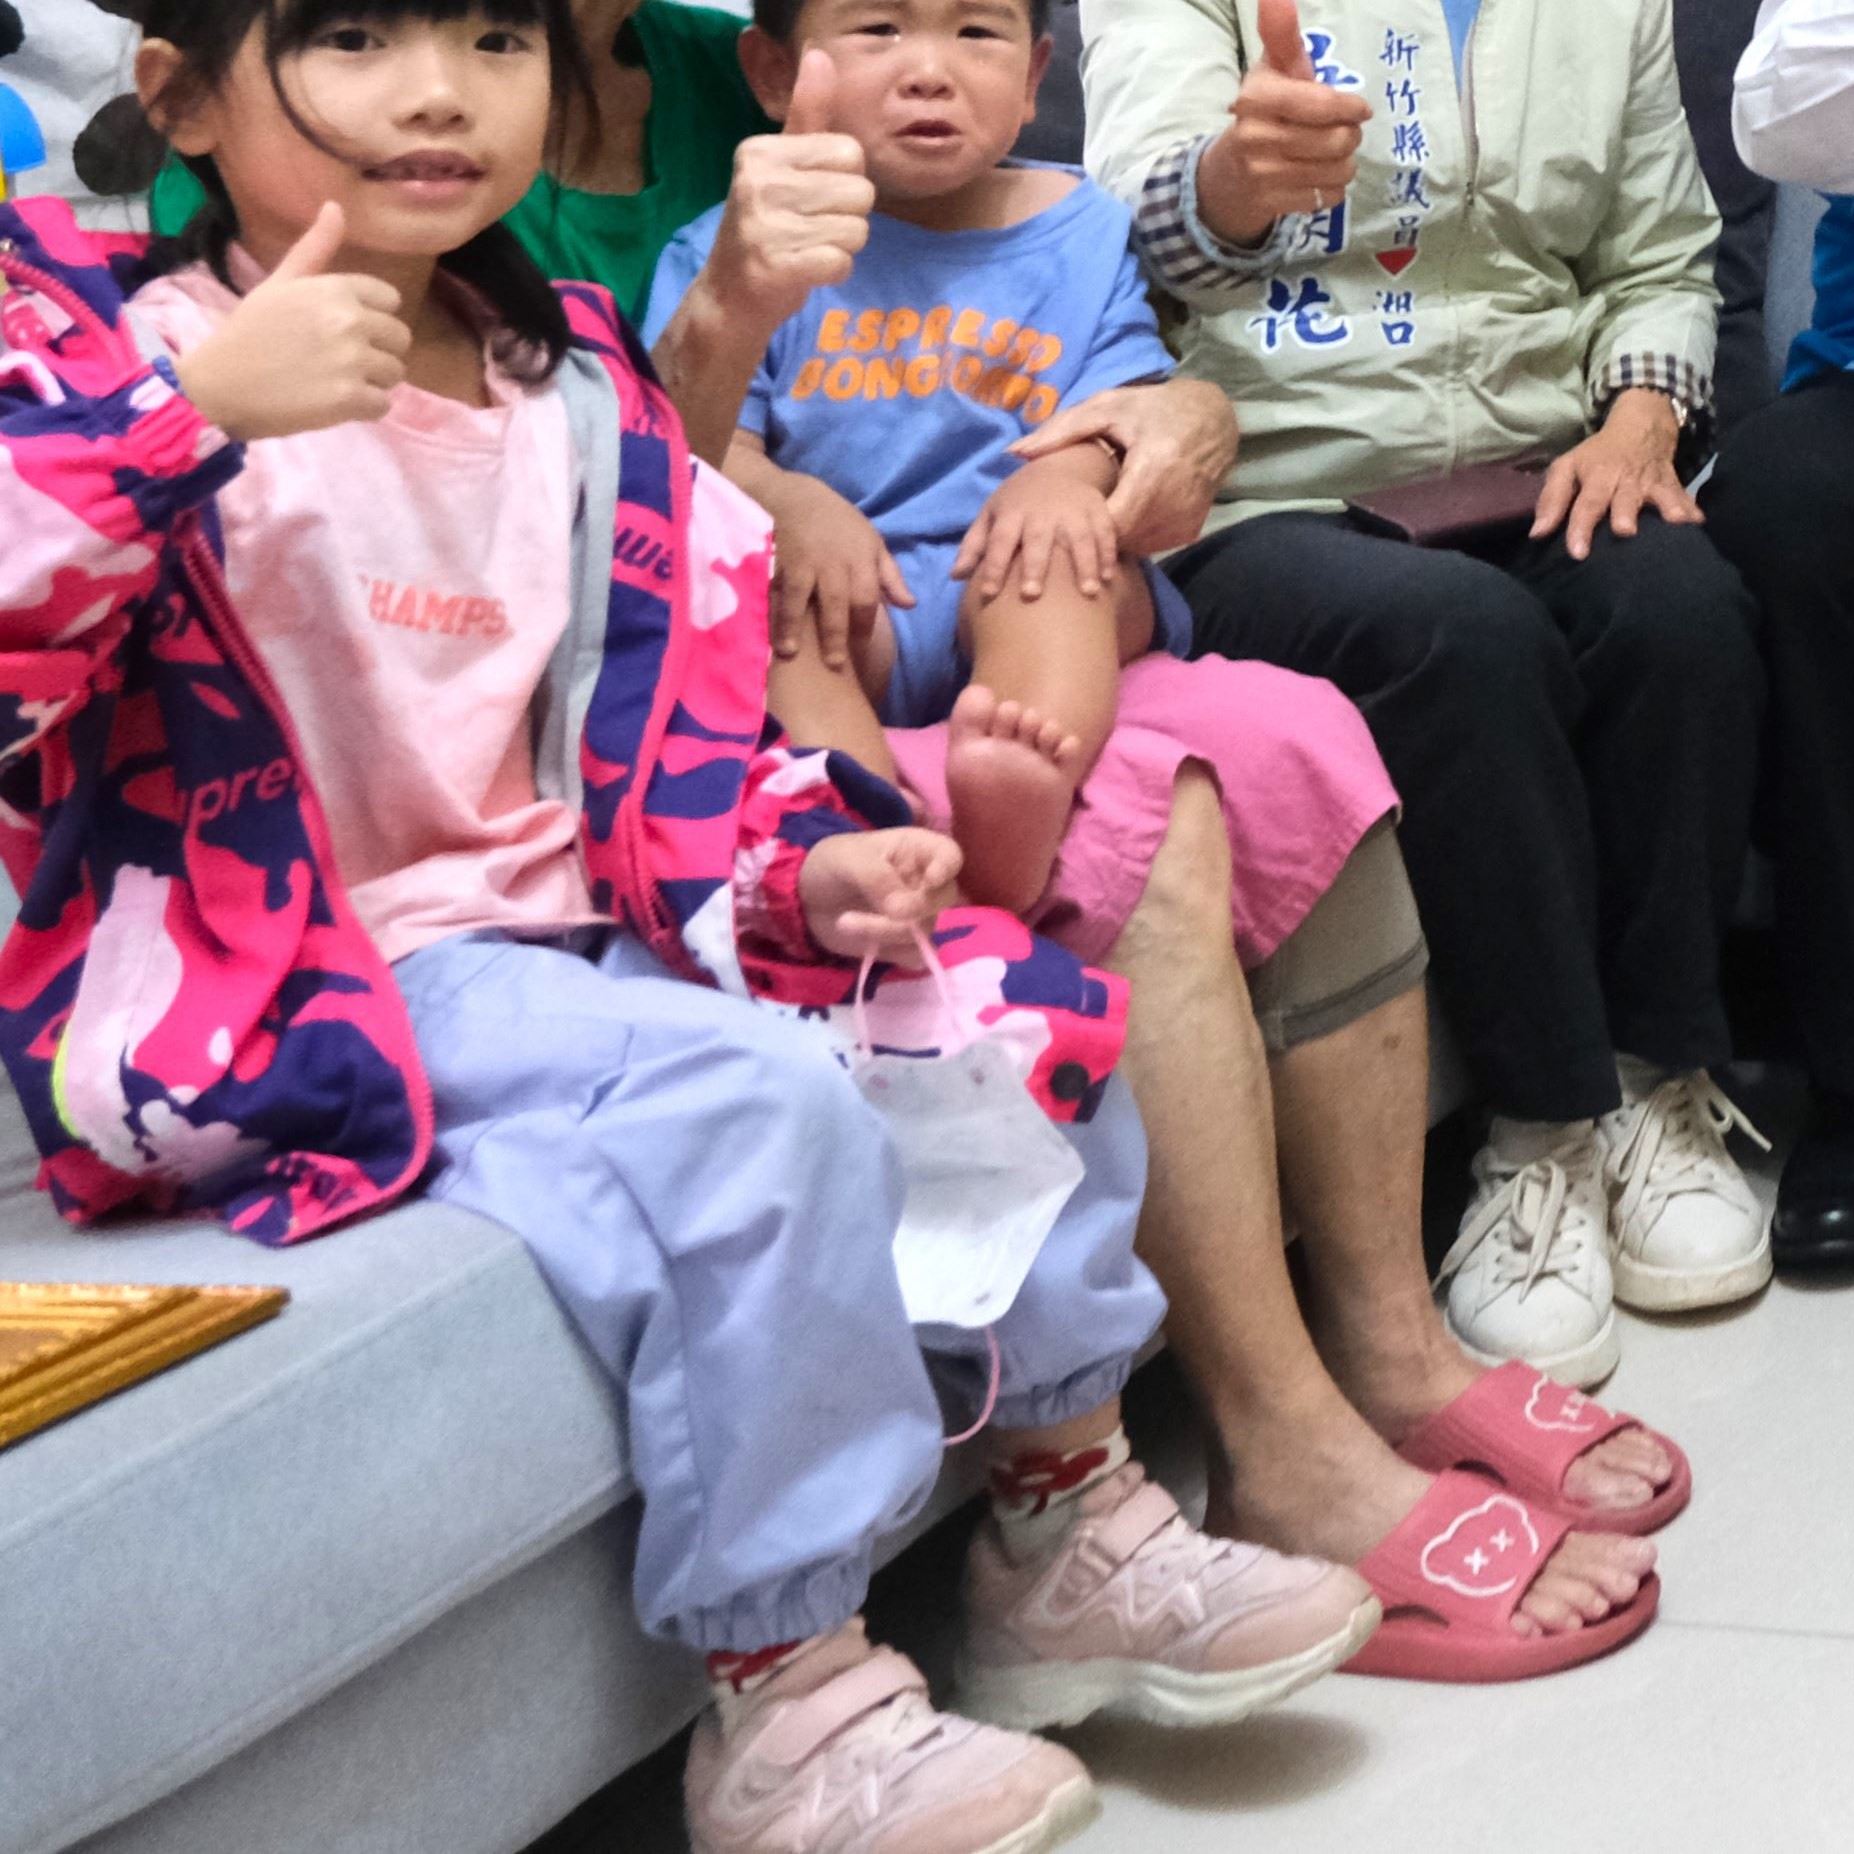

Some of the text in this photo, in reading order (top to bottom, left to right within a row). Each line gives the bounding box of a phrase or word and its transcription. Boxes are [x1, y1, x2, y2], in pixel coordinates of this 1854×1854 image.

[1378, 27, 1431, 247] 新竹縣議員
[358, 573, 510, 640] HAMPS
